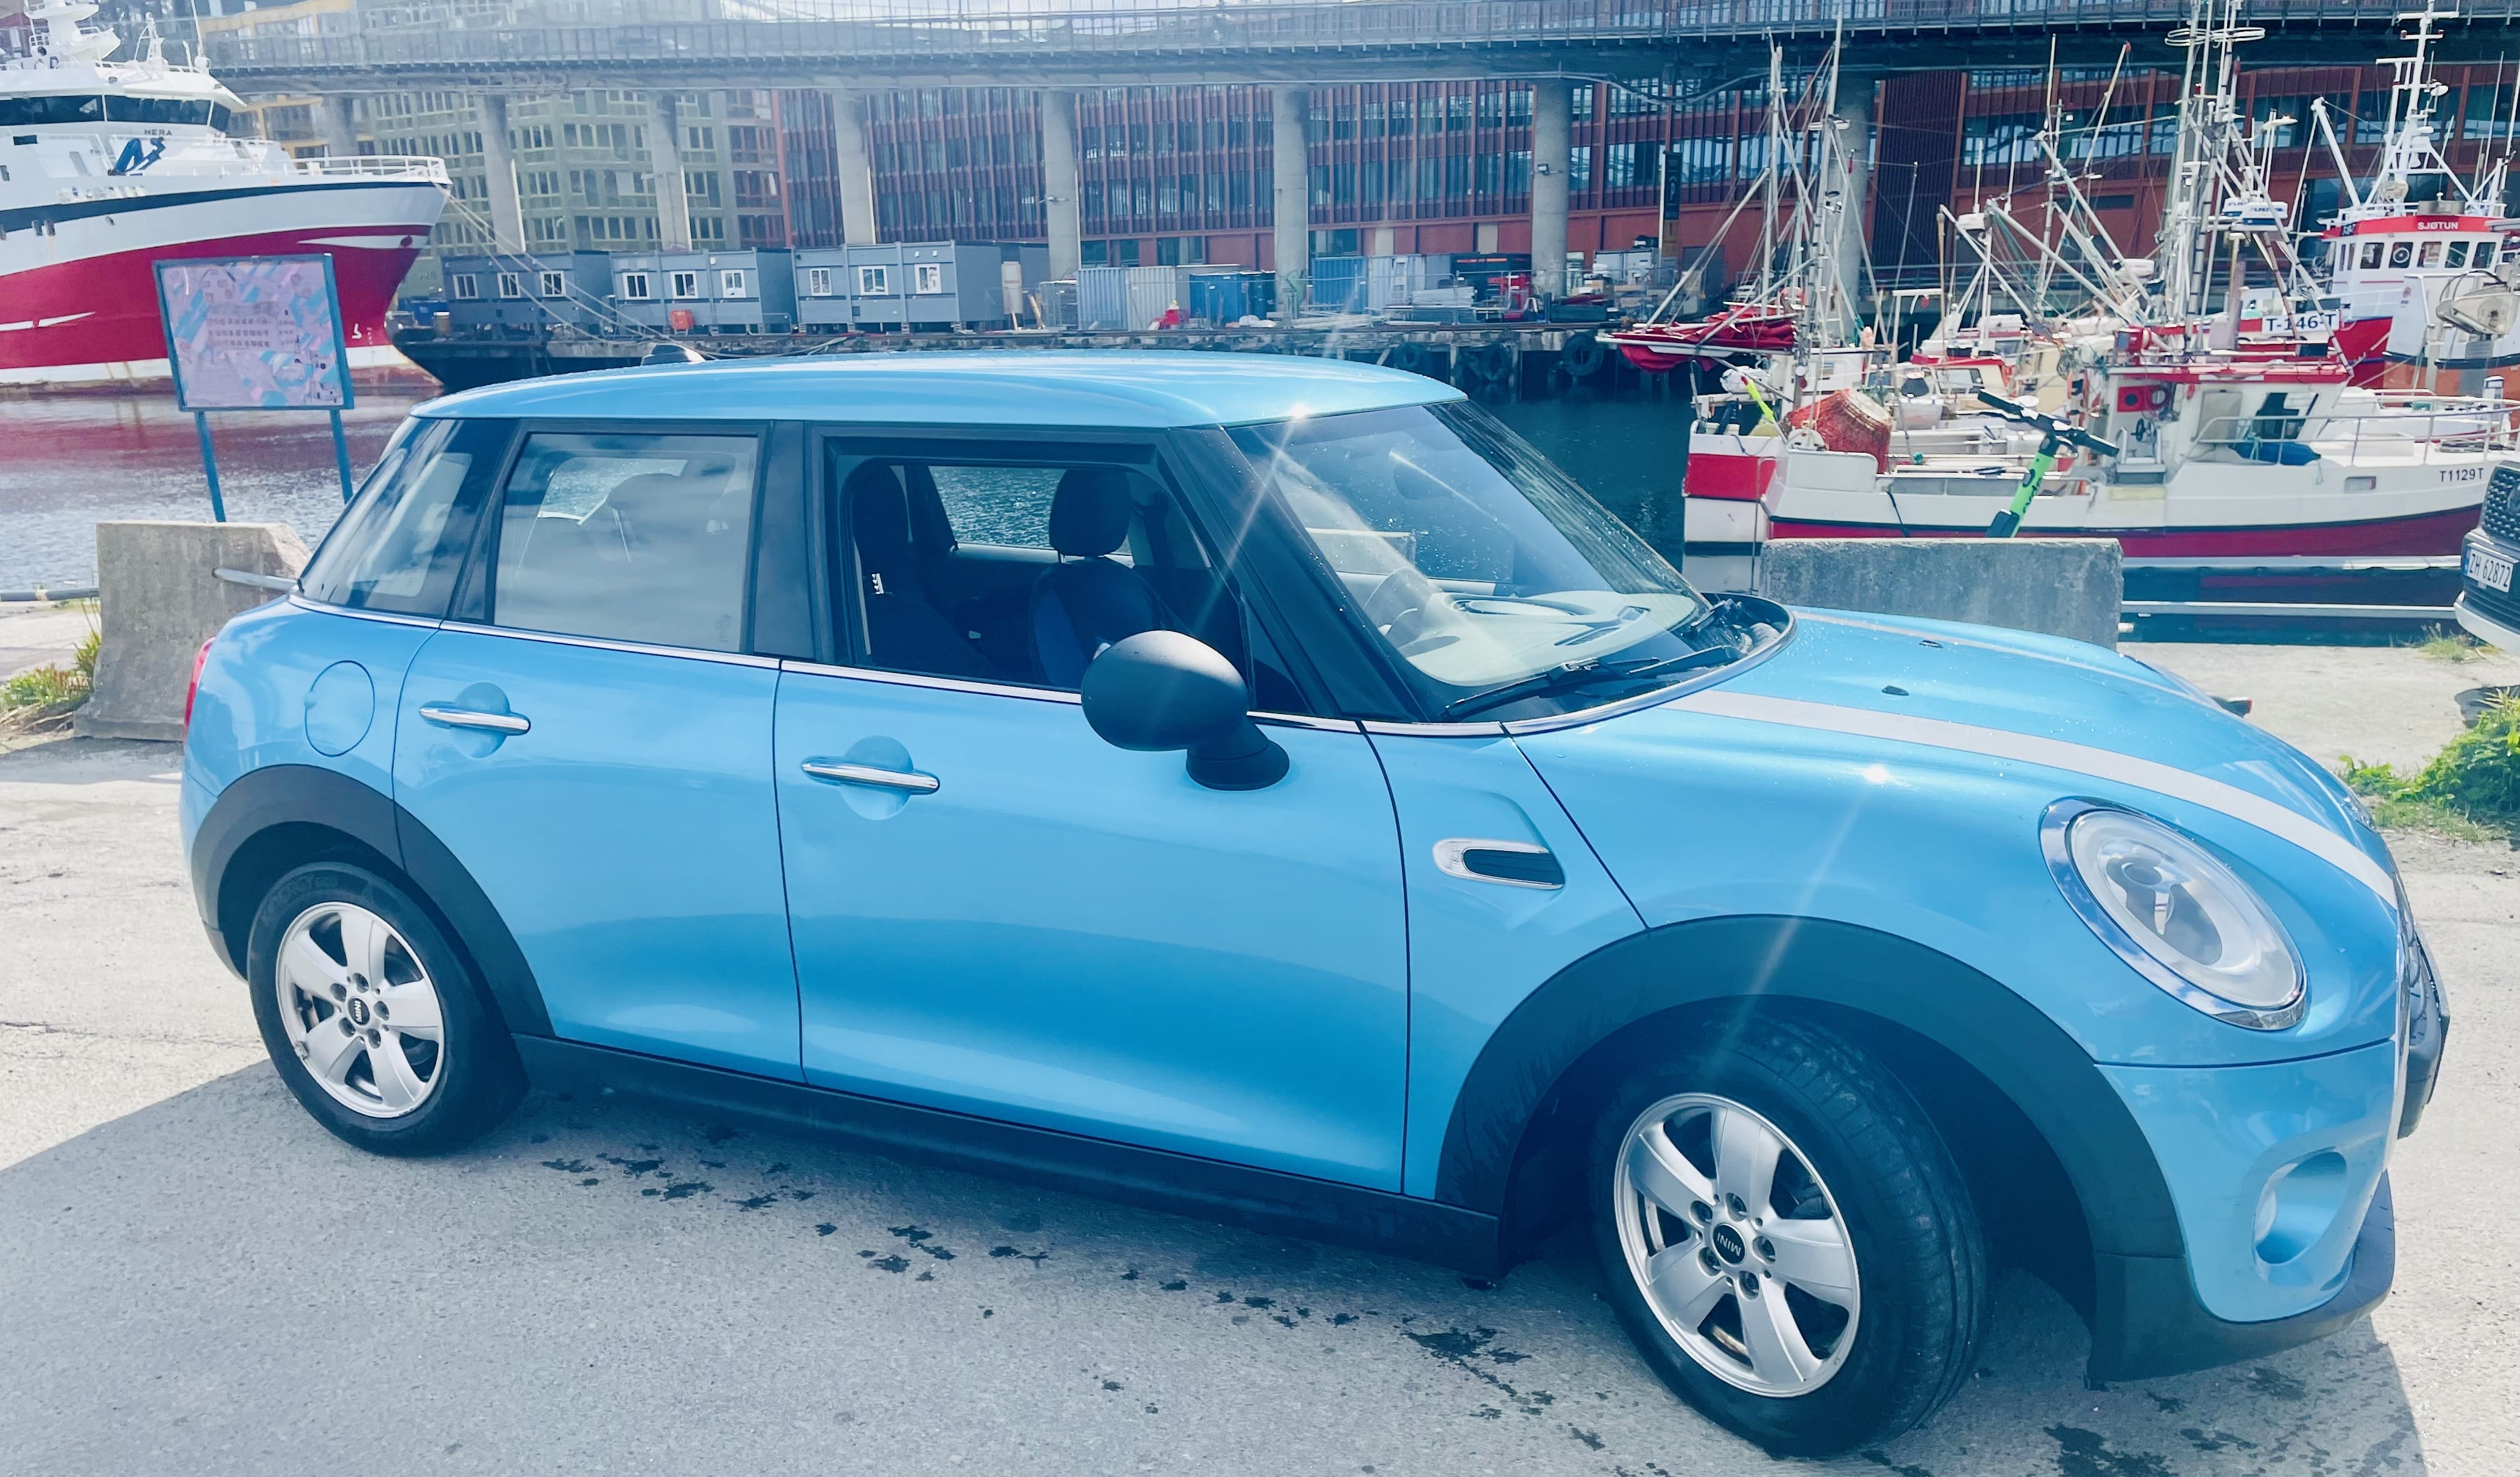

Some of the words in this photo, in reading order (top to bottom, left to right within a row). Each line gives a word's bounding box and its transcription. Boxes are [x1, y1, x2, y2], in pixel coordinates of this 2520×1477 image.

[2417, 221, 2459, 230] SJØTUN
[2439, 467, 2484, 482] T1129T
[2469, 553, 2482, 577] ZH
[2482, 558, 2511, 588] 62872
[354, 1000, 363, 1023] MINI
[1716, 1232, 1741, 1257] MINI
